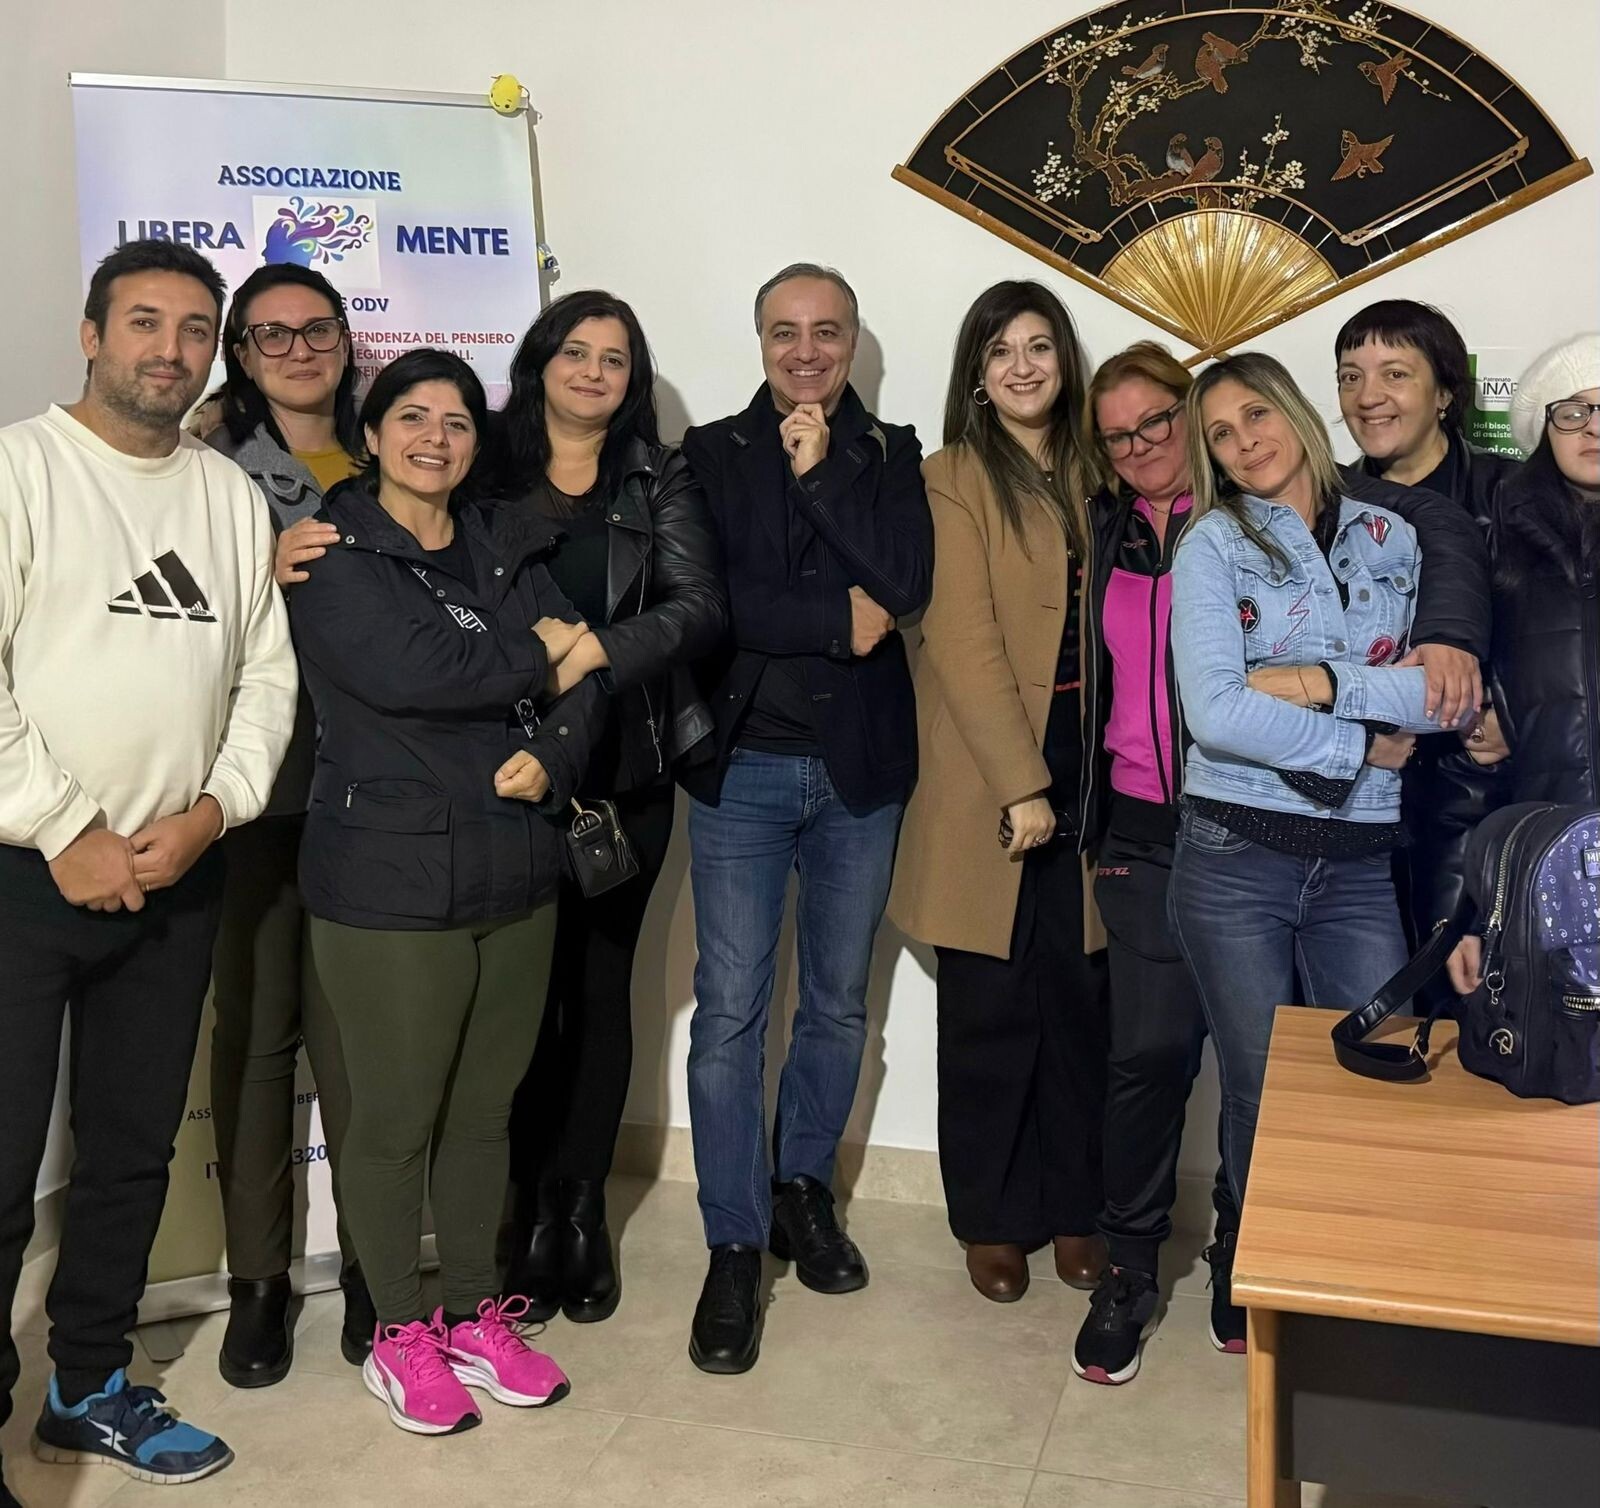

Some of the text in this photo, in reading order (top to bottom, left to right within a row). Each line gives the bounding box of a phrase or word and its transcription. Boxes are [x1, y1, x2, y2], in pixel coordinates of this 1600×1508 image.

[217, 165, 402, 191] ASSOCIAZIONE
[396, 225, 509, 255] MENTE
[351, 297, 389, 312] ODV
[425, 332, 448, 344] DEL
[452, 333, 515, 344] PENSIERO
[294, 1145, 328, 1165] 320
